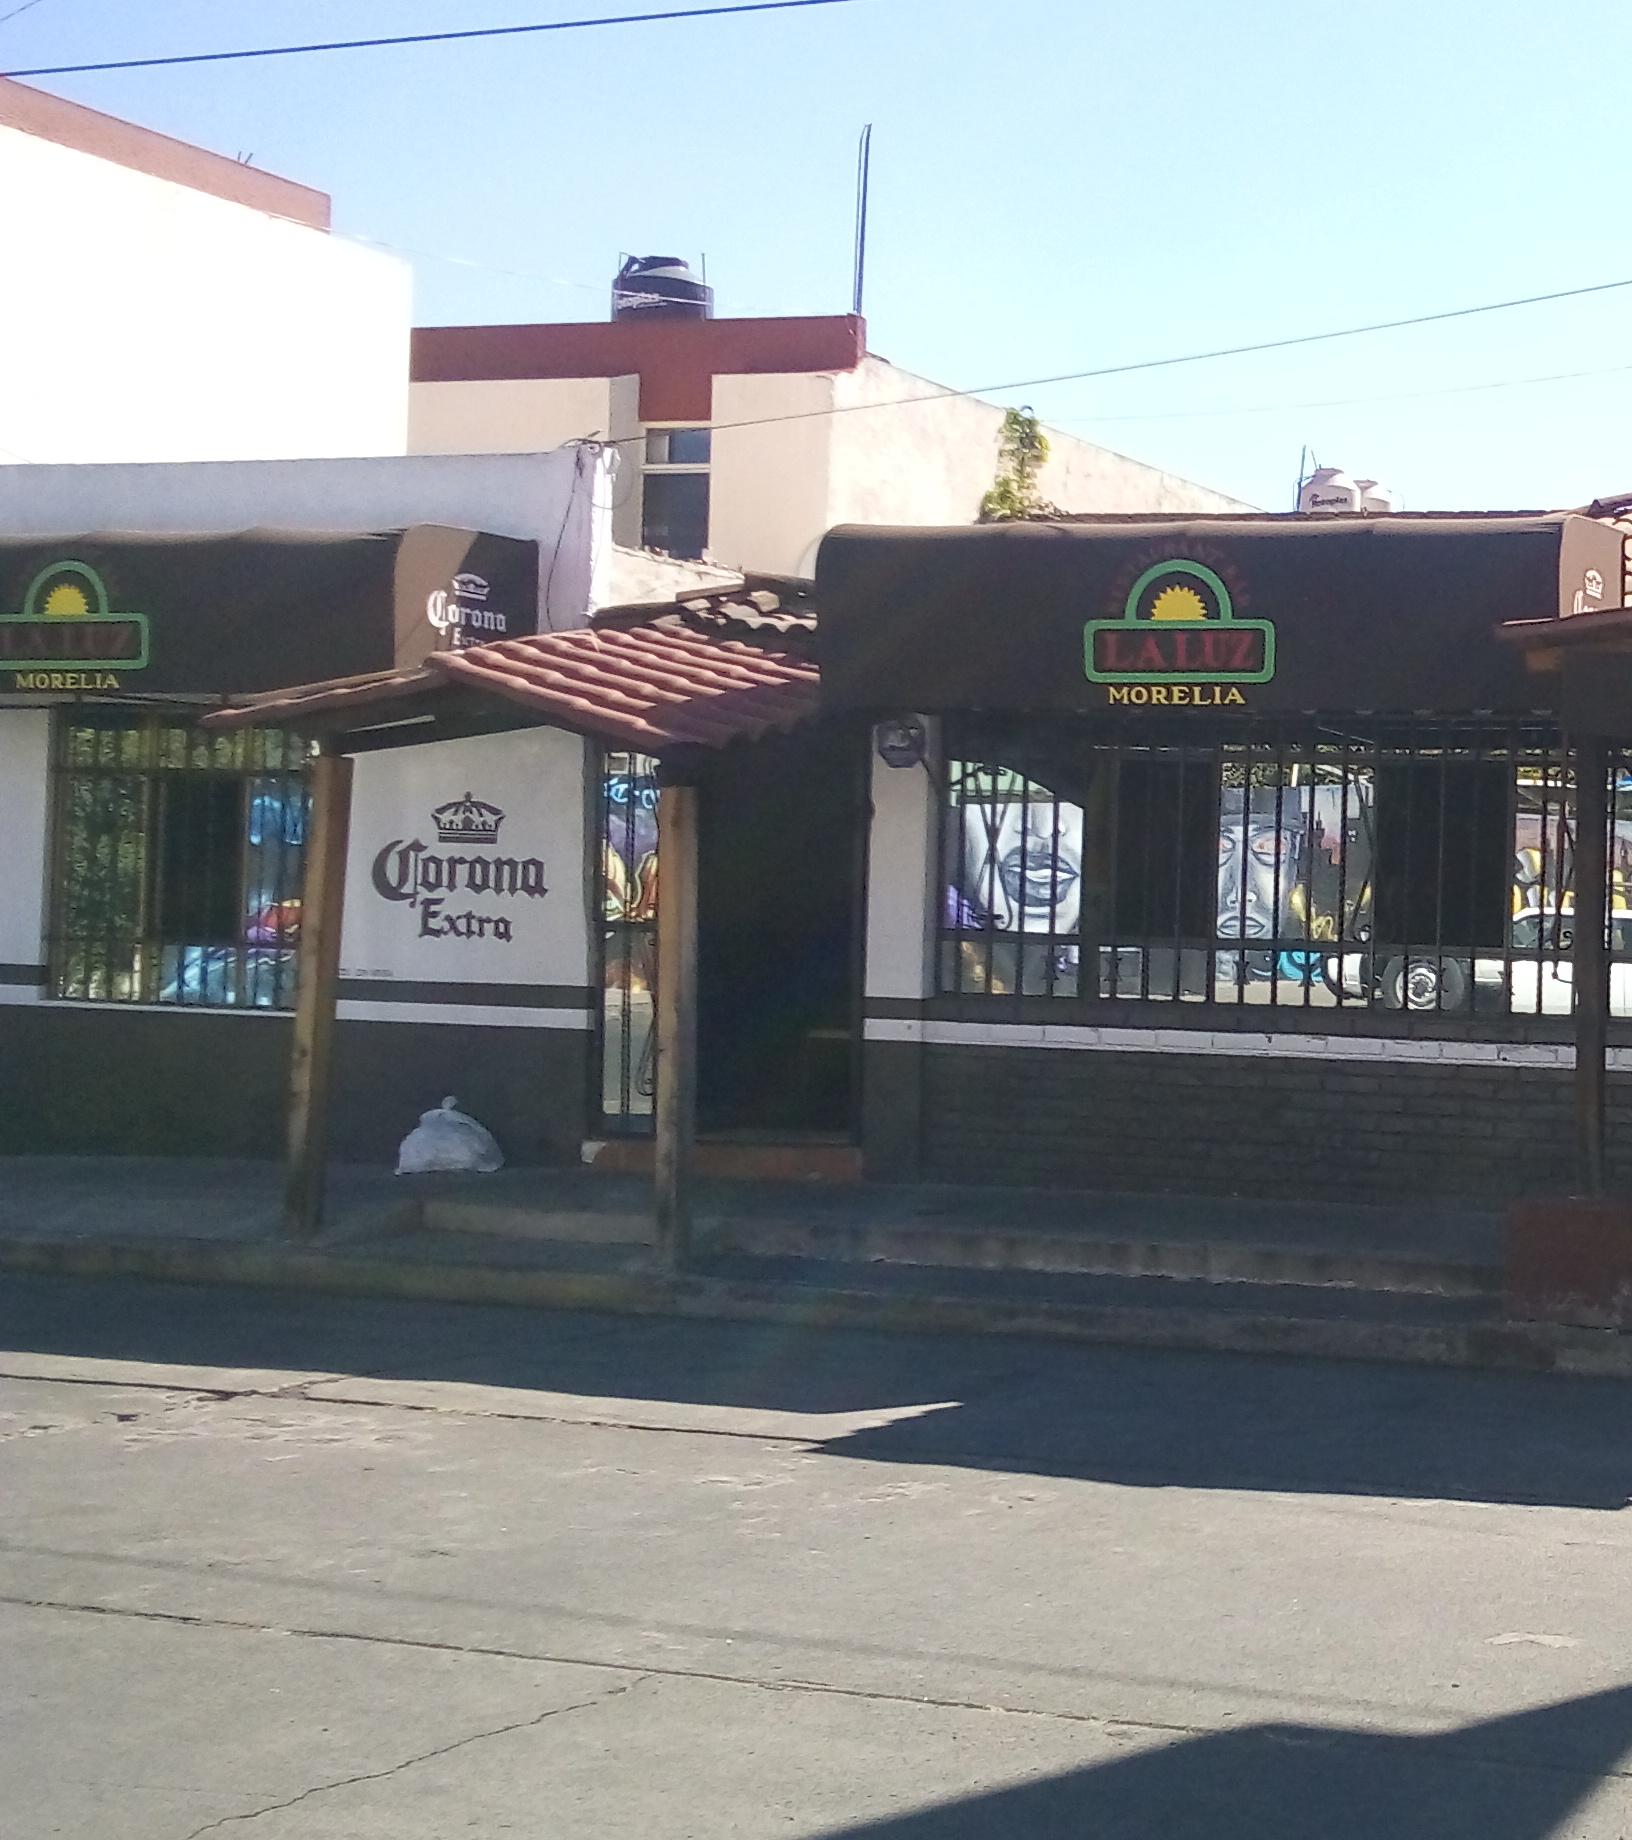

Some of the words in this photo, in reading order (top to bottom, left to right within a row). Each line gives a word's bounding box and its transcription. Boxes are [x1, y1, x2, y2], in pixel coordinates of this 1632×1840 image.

[426, 589, 507, 636] Corona
[1103, 630, 1167, 669] LA
[1174, 630, 1254, 669] LUZ
[16, 672, 120, 689] MORELIA
[1108, 686, 1247, 705] MORELIA
[372, 837, 549, 909] Corona
[418, 897, 513, 943] Extra
